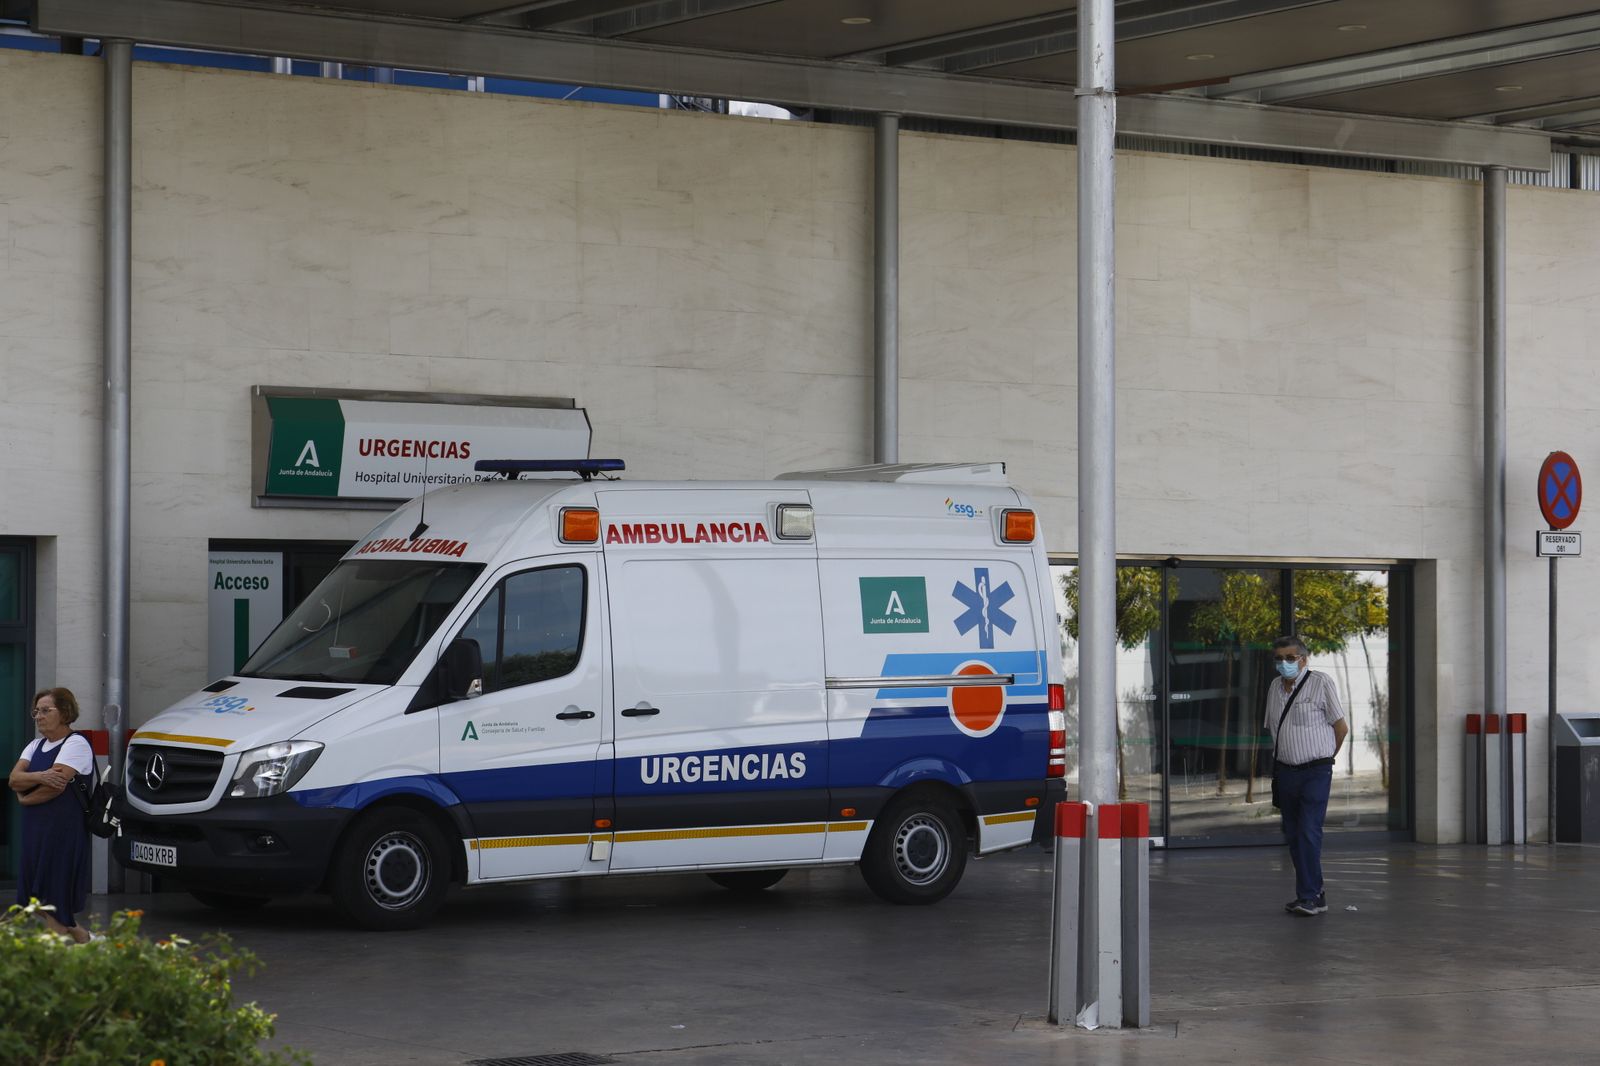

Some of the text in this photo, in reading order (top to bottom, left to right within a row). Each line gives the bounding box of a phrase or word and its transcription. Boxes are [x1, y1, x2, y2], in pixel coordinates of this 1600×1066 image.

[359, 438, 471, 460] URGENCIAS
[355, 471, 400, 485] Hospital
[403, 472, 472, 485] Universitario
[606, 523, 769, 545] AMBULANCIA
[1545, 535, 1576, 543] RESERVADO
[214, 571, 270, 590] Acceso
[870, 617, 886, 625] Junta
[886, 617, 894, 625] de
[640, 752, 807, 785] URGENCIAS
[155, 847, 174, 864] KRB
